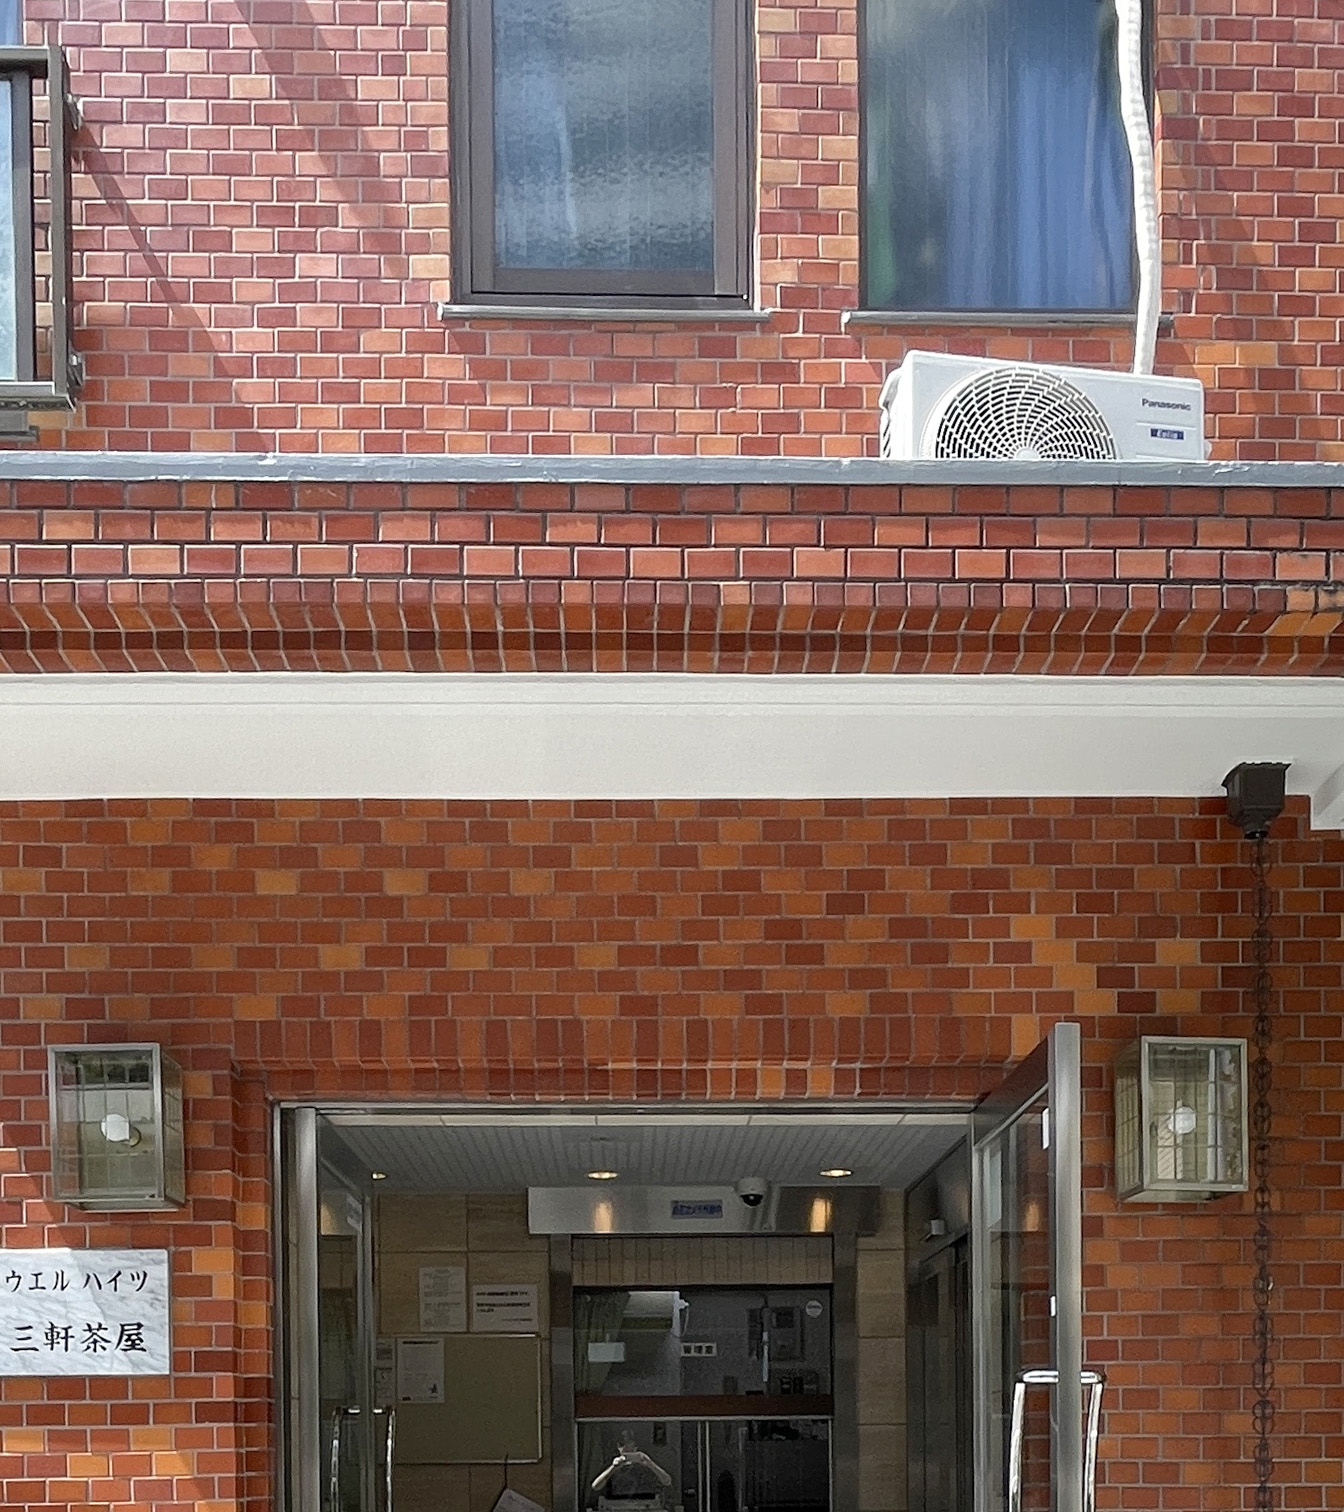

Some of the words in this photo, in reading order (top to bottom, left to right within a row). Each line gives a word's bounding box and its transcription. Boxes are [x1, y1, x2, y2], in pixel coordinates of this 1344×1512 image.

[1142, 398, 1191, 411] Panasonic
[82, 1270, 149, 1292] ハイツ
